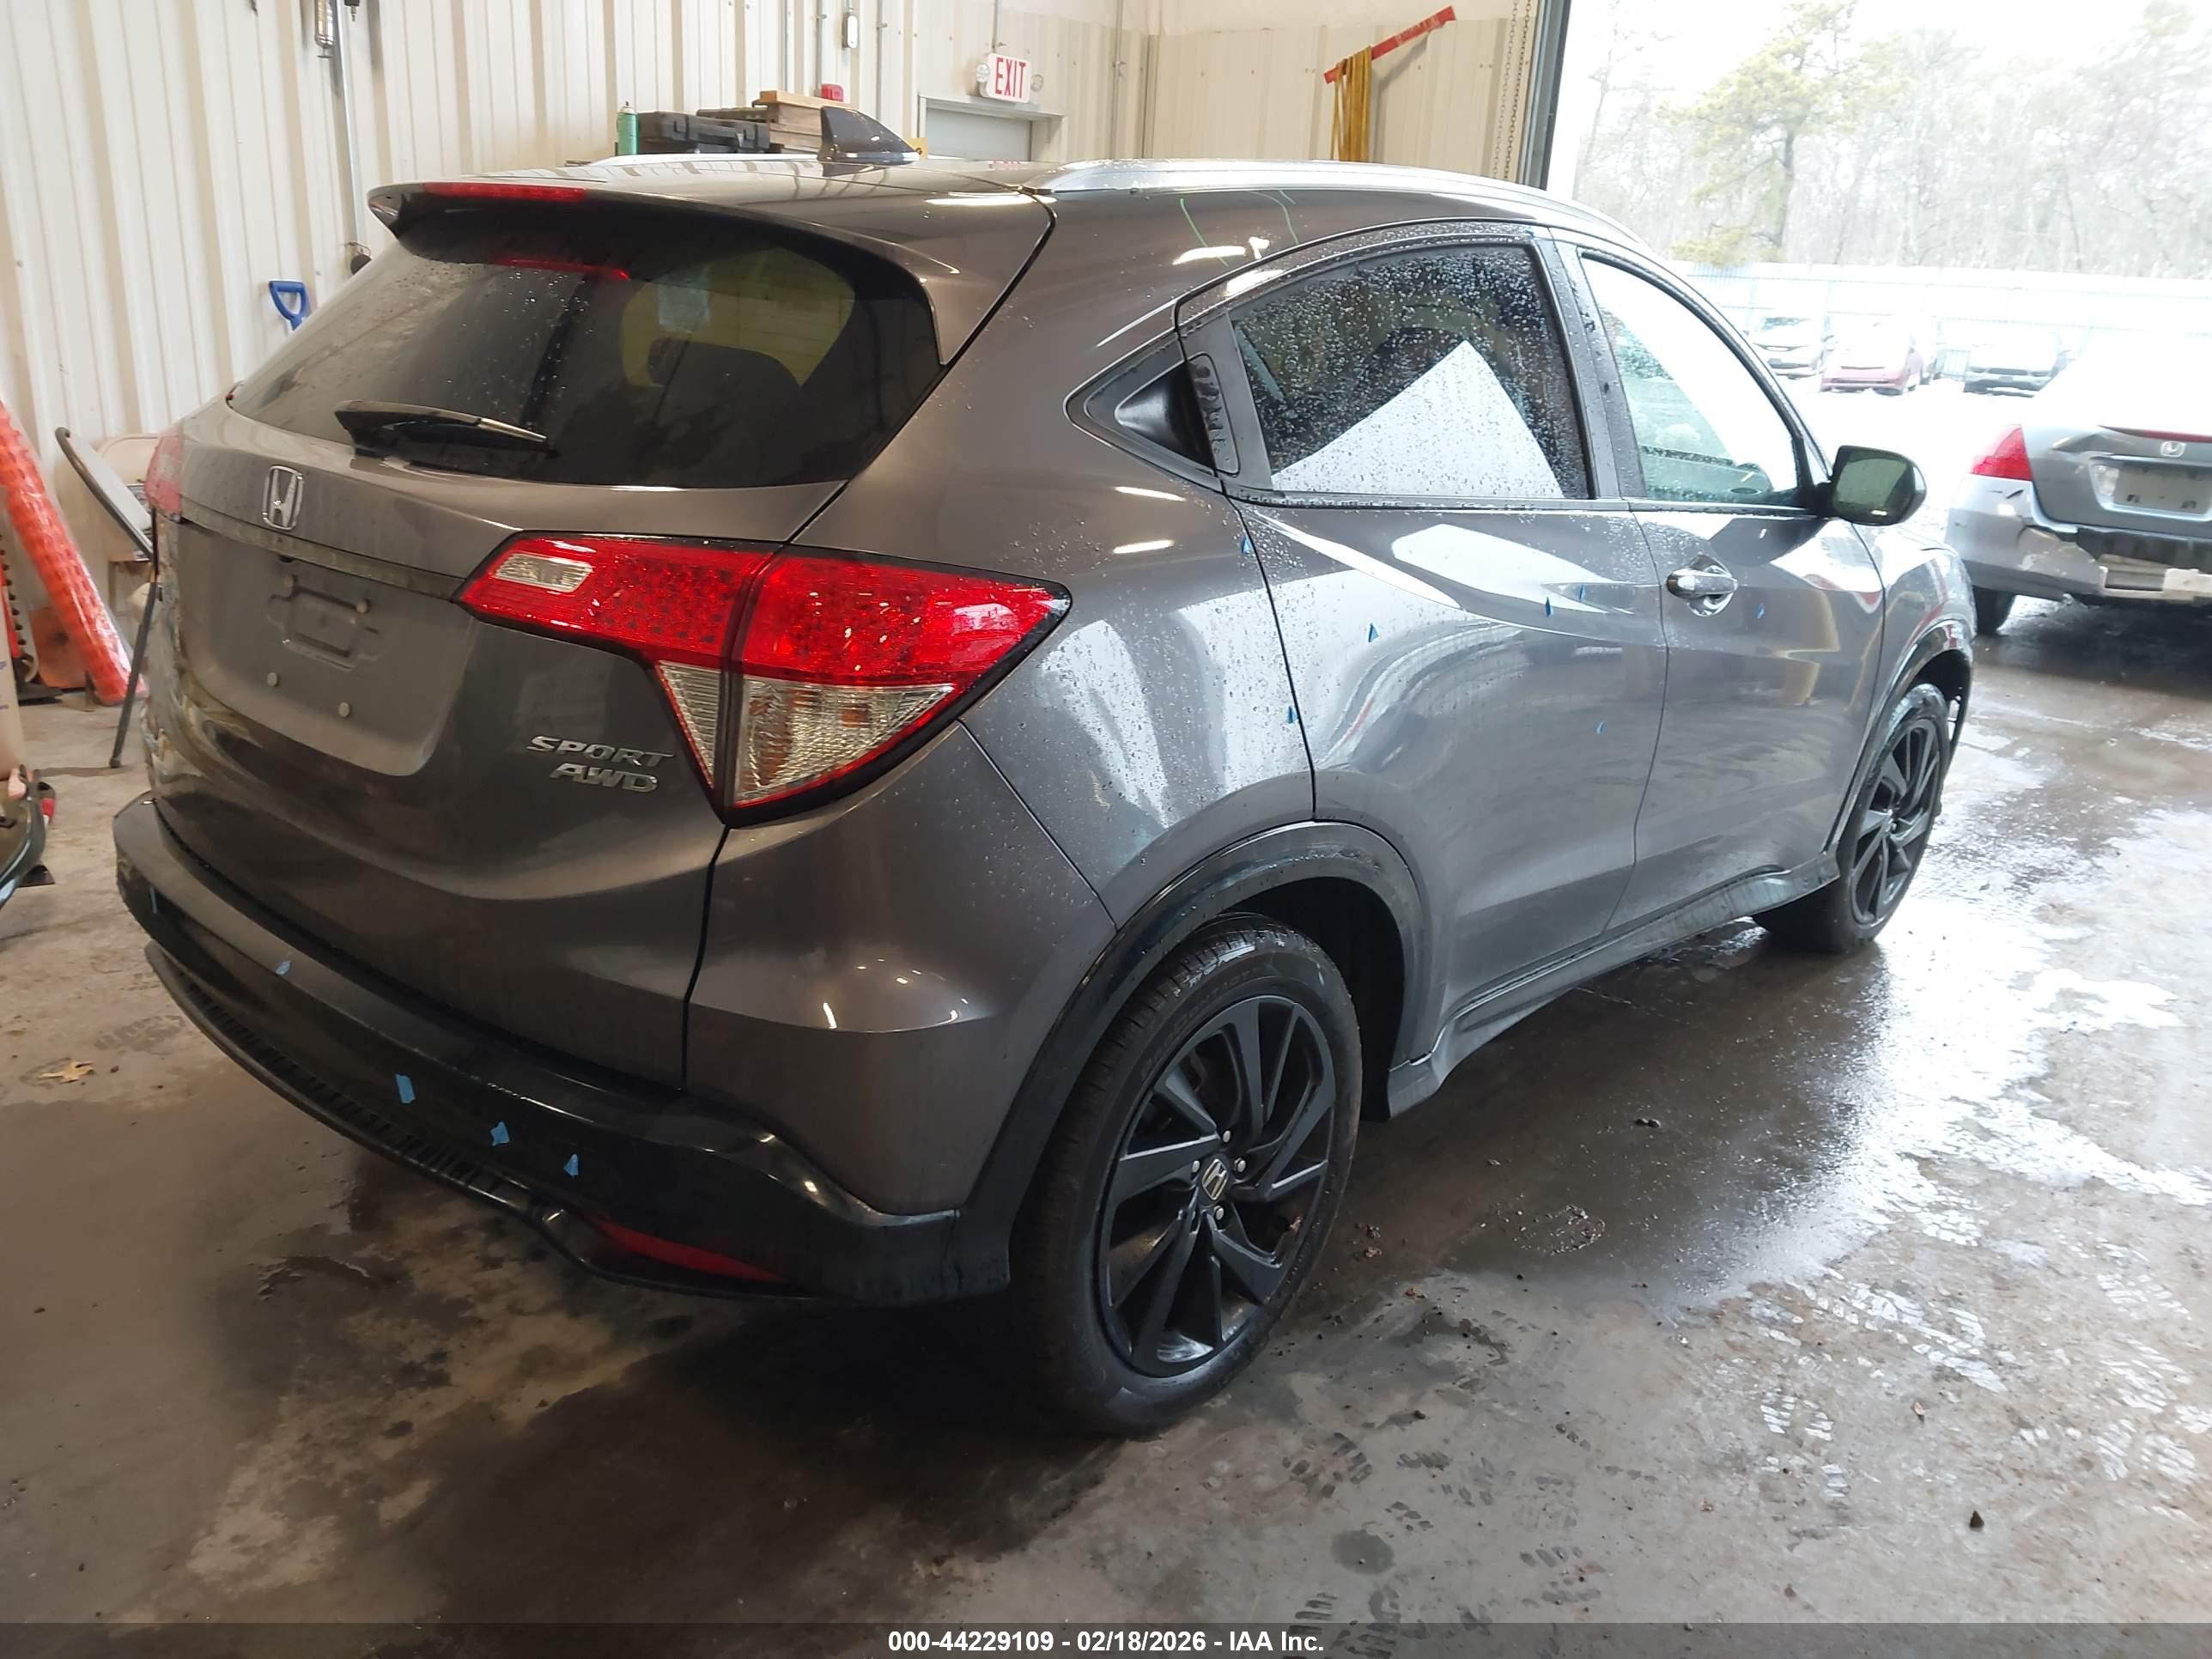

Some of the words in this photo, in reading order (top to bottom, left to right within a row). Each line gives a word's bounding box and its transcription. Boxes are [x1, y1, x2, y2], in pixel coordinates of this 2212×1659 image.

[995, 57, 1026, 99] EXIT
[526, 735, 674, 767] SPORT
[549, 763, 658, 793] AWD
